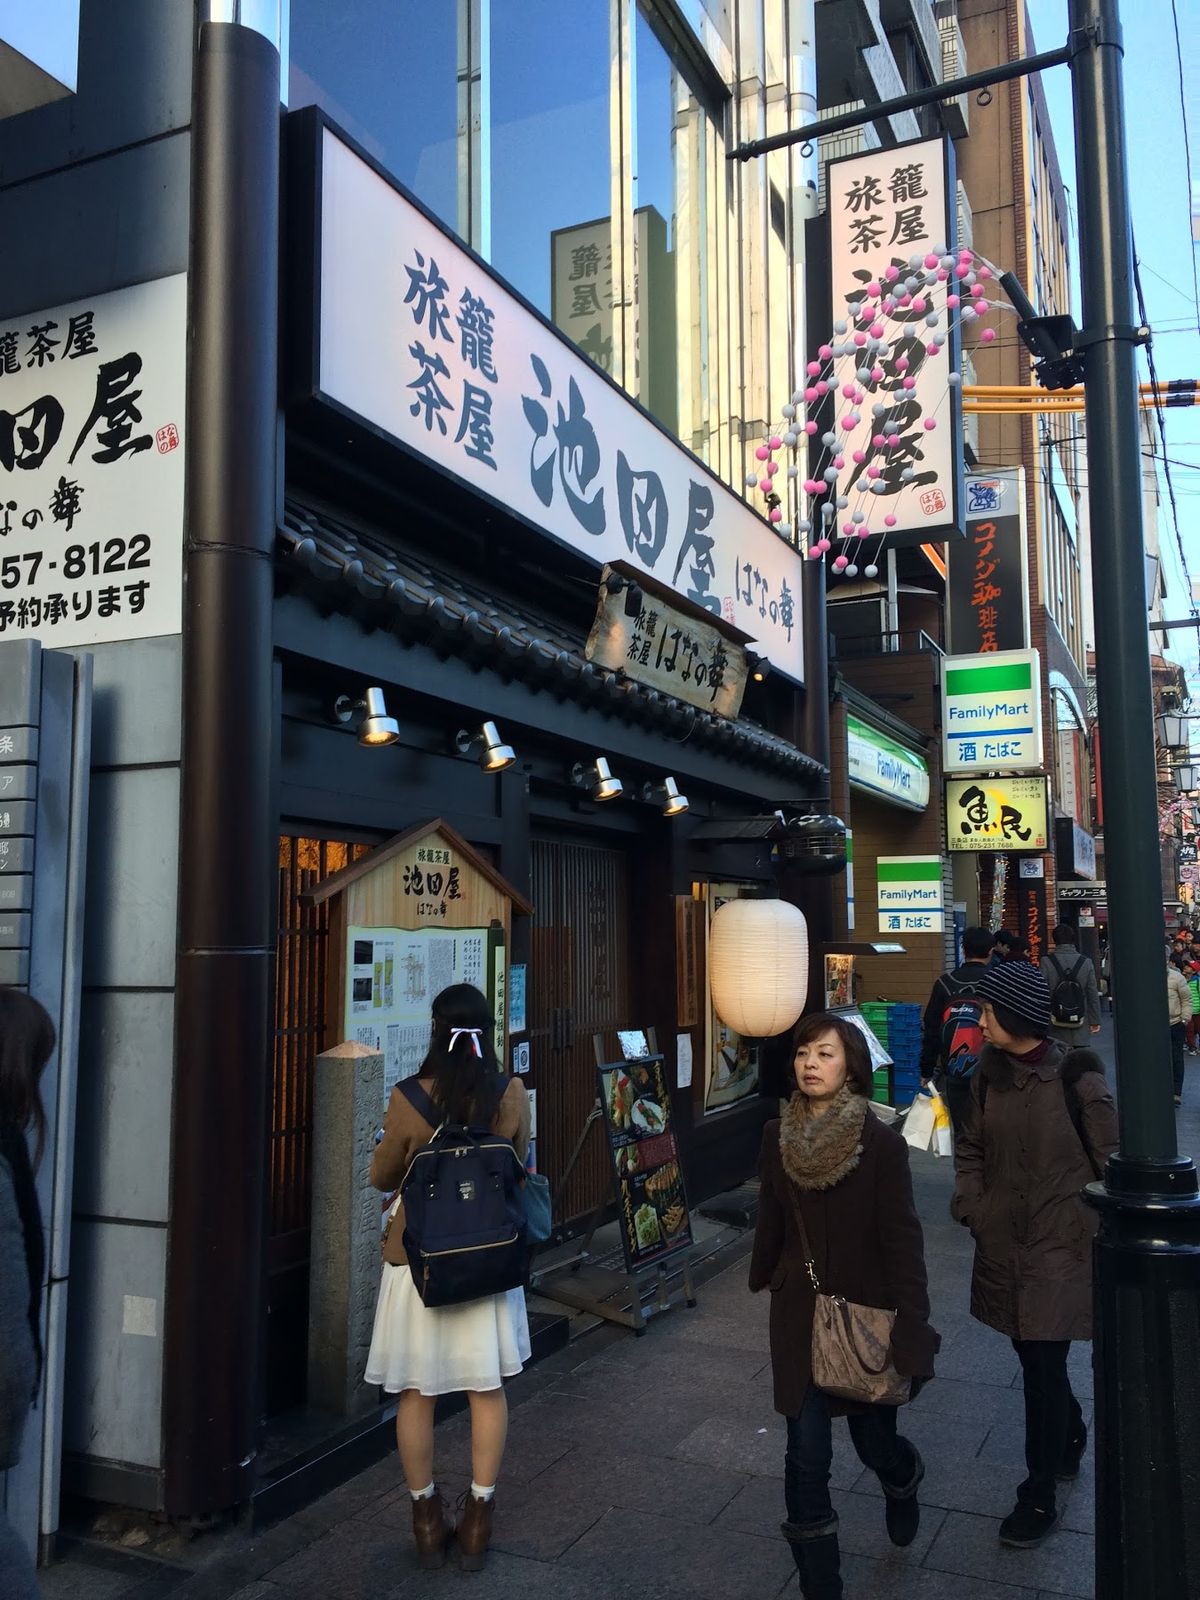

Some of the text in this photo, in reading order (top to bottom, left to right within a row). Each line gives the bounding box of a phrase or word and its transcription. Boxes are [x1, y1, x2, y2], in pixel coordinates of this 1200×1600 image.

[844, 163, 928, 213] 旅籠
[847, 205, 929, 254] 茶屋
[404, 249, 498, 384] 旅籠
[406, 340, 498, 472] 茶屋
[521, 353, 722, 618] 池田屋
[949, 703, 1028, 720] FamilyMart
[959, 741, 1022, 761] 酒 たばこ
[877, 752, 911, 789] FamilyMart
[403, 864, 461, 900] 池田屋
[880, 889, 937, 901] FamilyMart
[888, 916, 932, 929] 酒 たばこ
